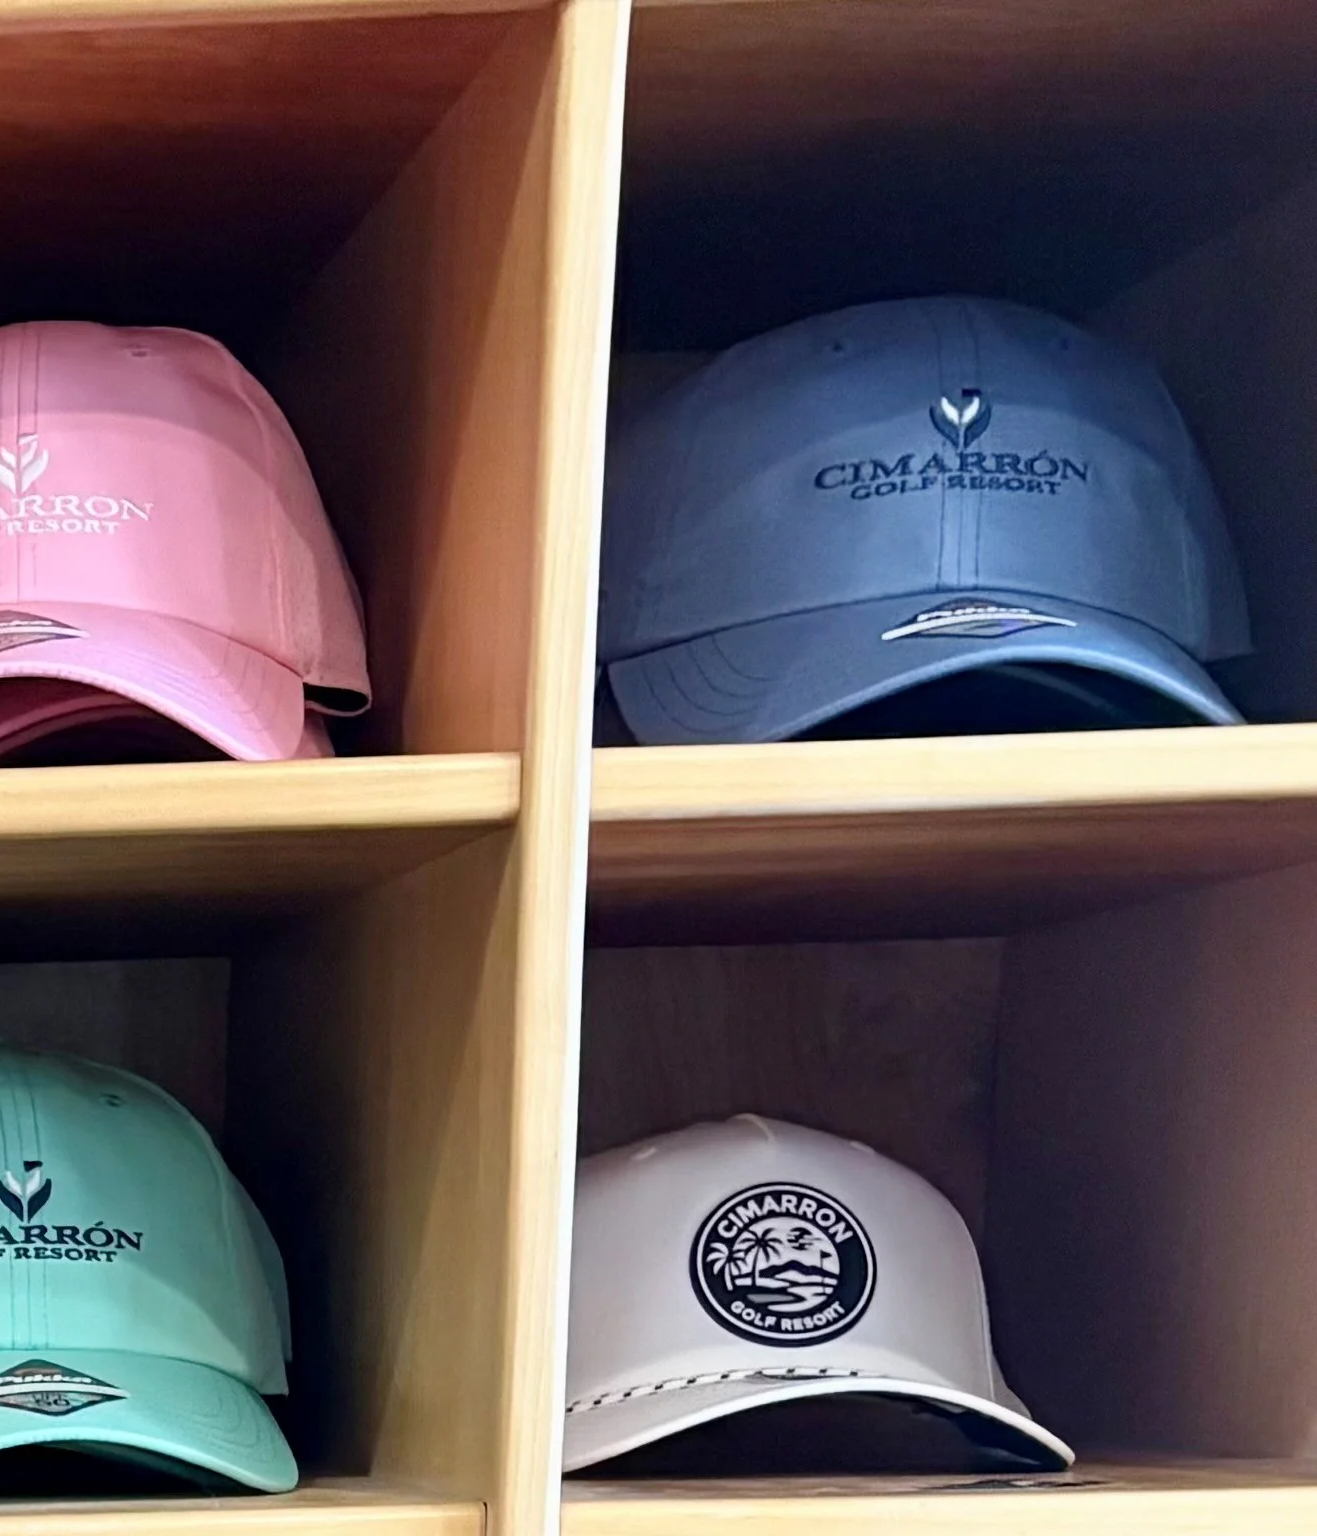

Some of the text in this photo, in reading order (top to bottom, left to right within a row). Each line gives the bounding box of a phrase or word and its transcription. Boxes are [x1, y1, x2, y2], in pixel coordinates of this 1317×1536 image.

[812, 447, 1091, 491] CIMARRÓN
[850, 475, 1062, 501] GOLF RESORT
[4, 518, 120, 537] RESORT
[717, 1194, 854, 1244] CIMARRON
[13, 1245, 118, 1265] RESORT
[729, 1300, 845, 1331] GOLF RESORT
